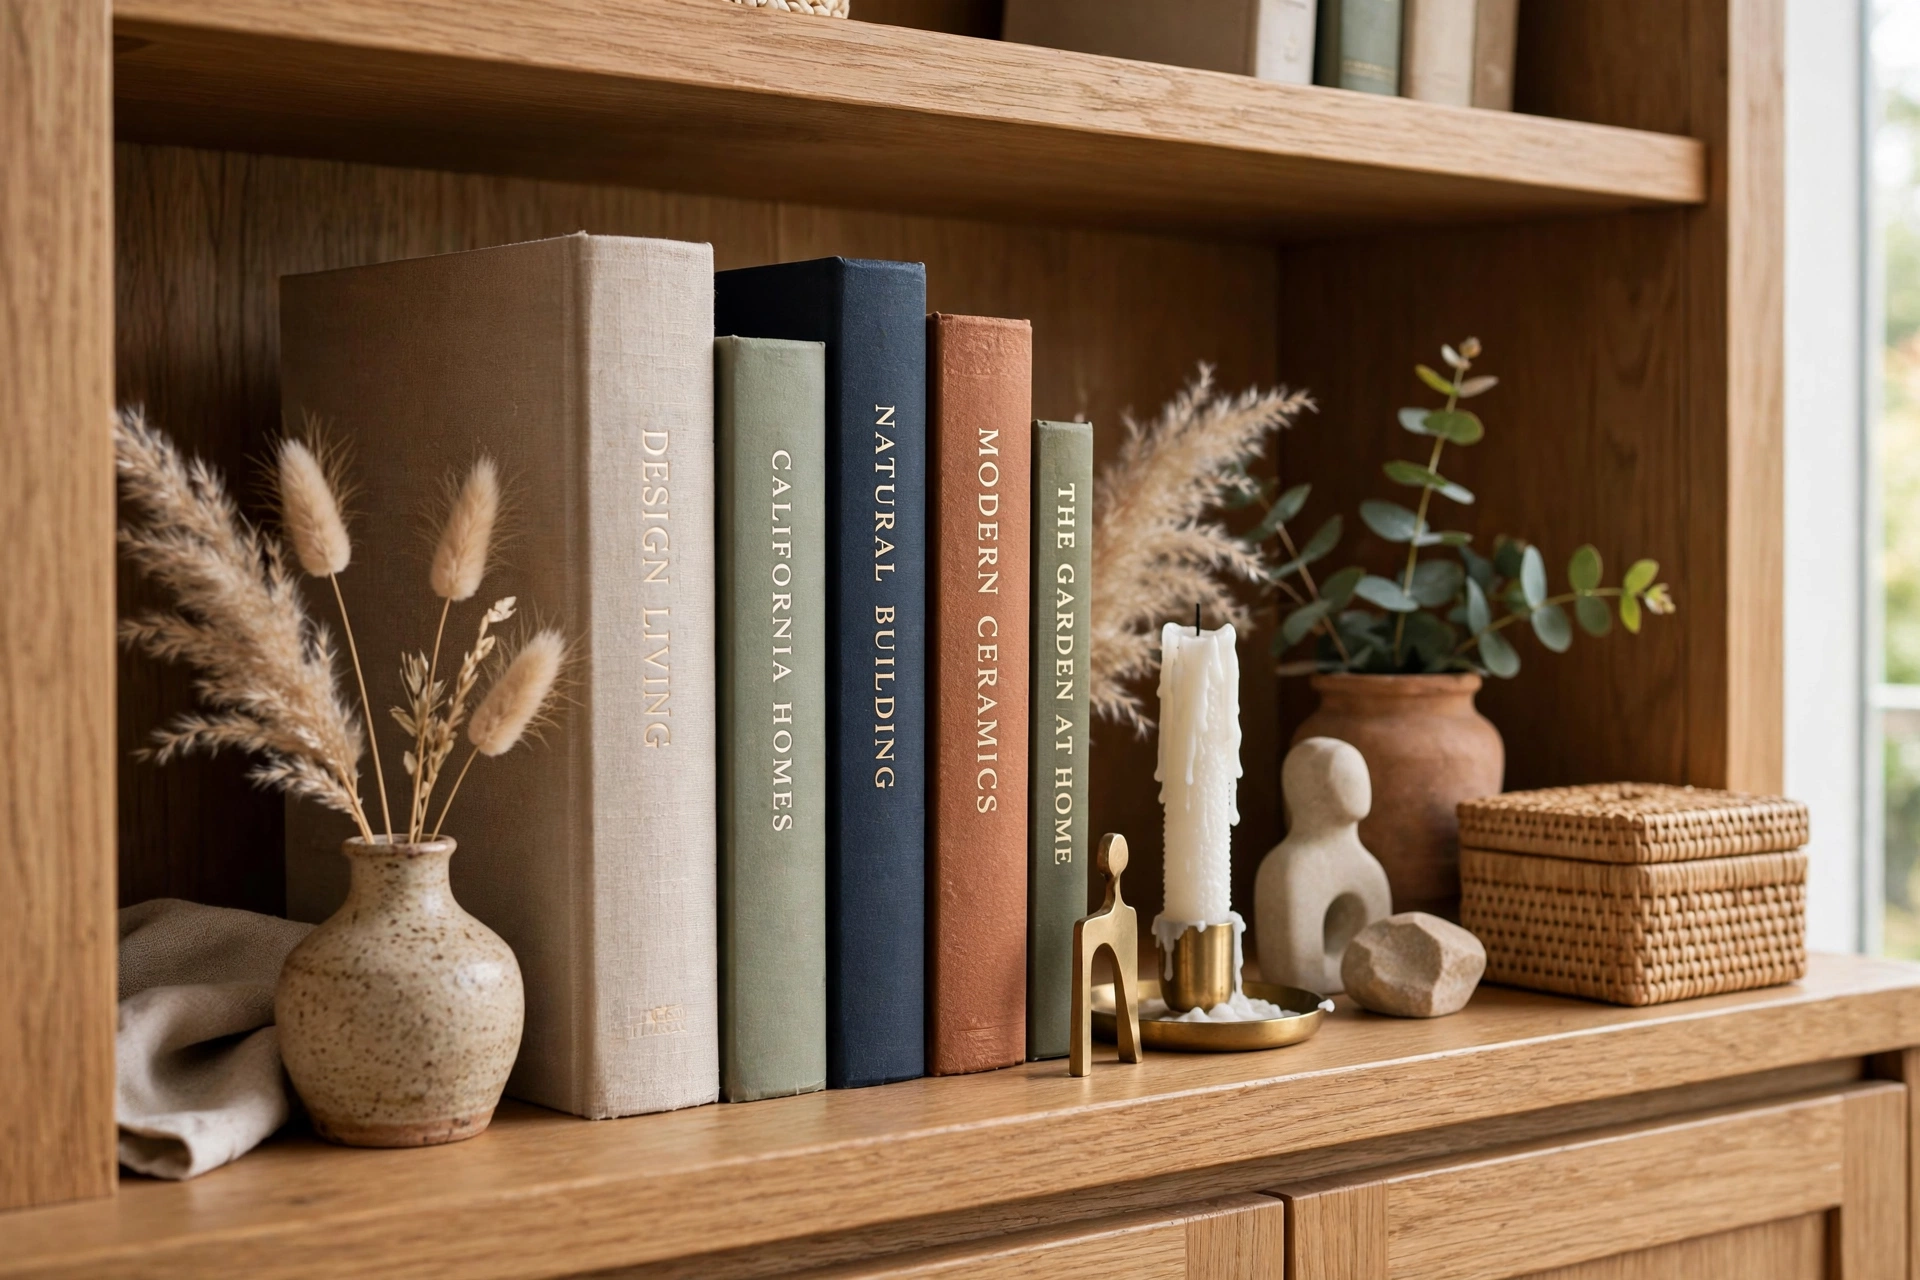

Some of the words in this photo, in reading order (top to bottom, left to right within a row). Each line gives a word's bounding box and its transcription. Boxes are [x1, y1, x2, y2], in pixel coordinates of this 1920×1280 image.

[641, 429, 670, 585] DESIGN
[771, 449, 794, 683] CALIFORNIA
[874, 404, 895, 582] NATURAL
[977, 427, 1000, 596] MODERN
[1056, 482, 1076, 550] THE
[642, 608, 672, 750] LIVING
[874, 605, 895, 790] BUILDING
[1055, 562, 1075, 702] GARDEN
[771, 702, 794, 833] HOMES
[976, 615, 999, 815] CERAMICS
[1055, 715, 1074, 755] AT
[1054, 767, 1073, 866] HOME
